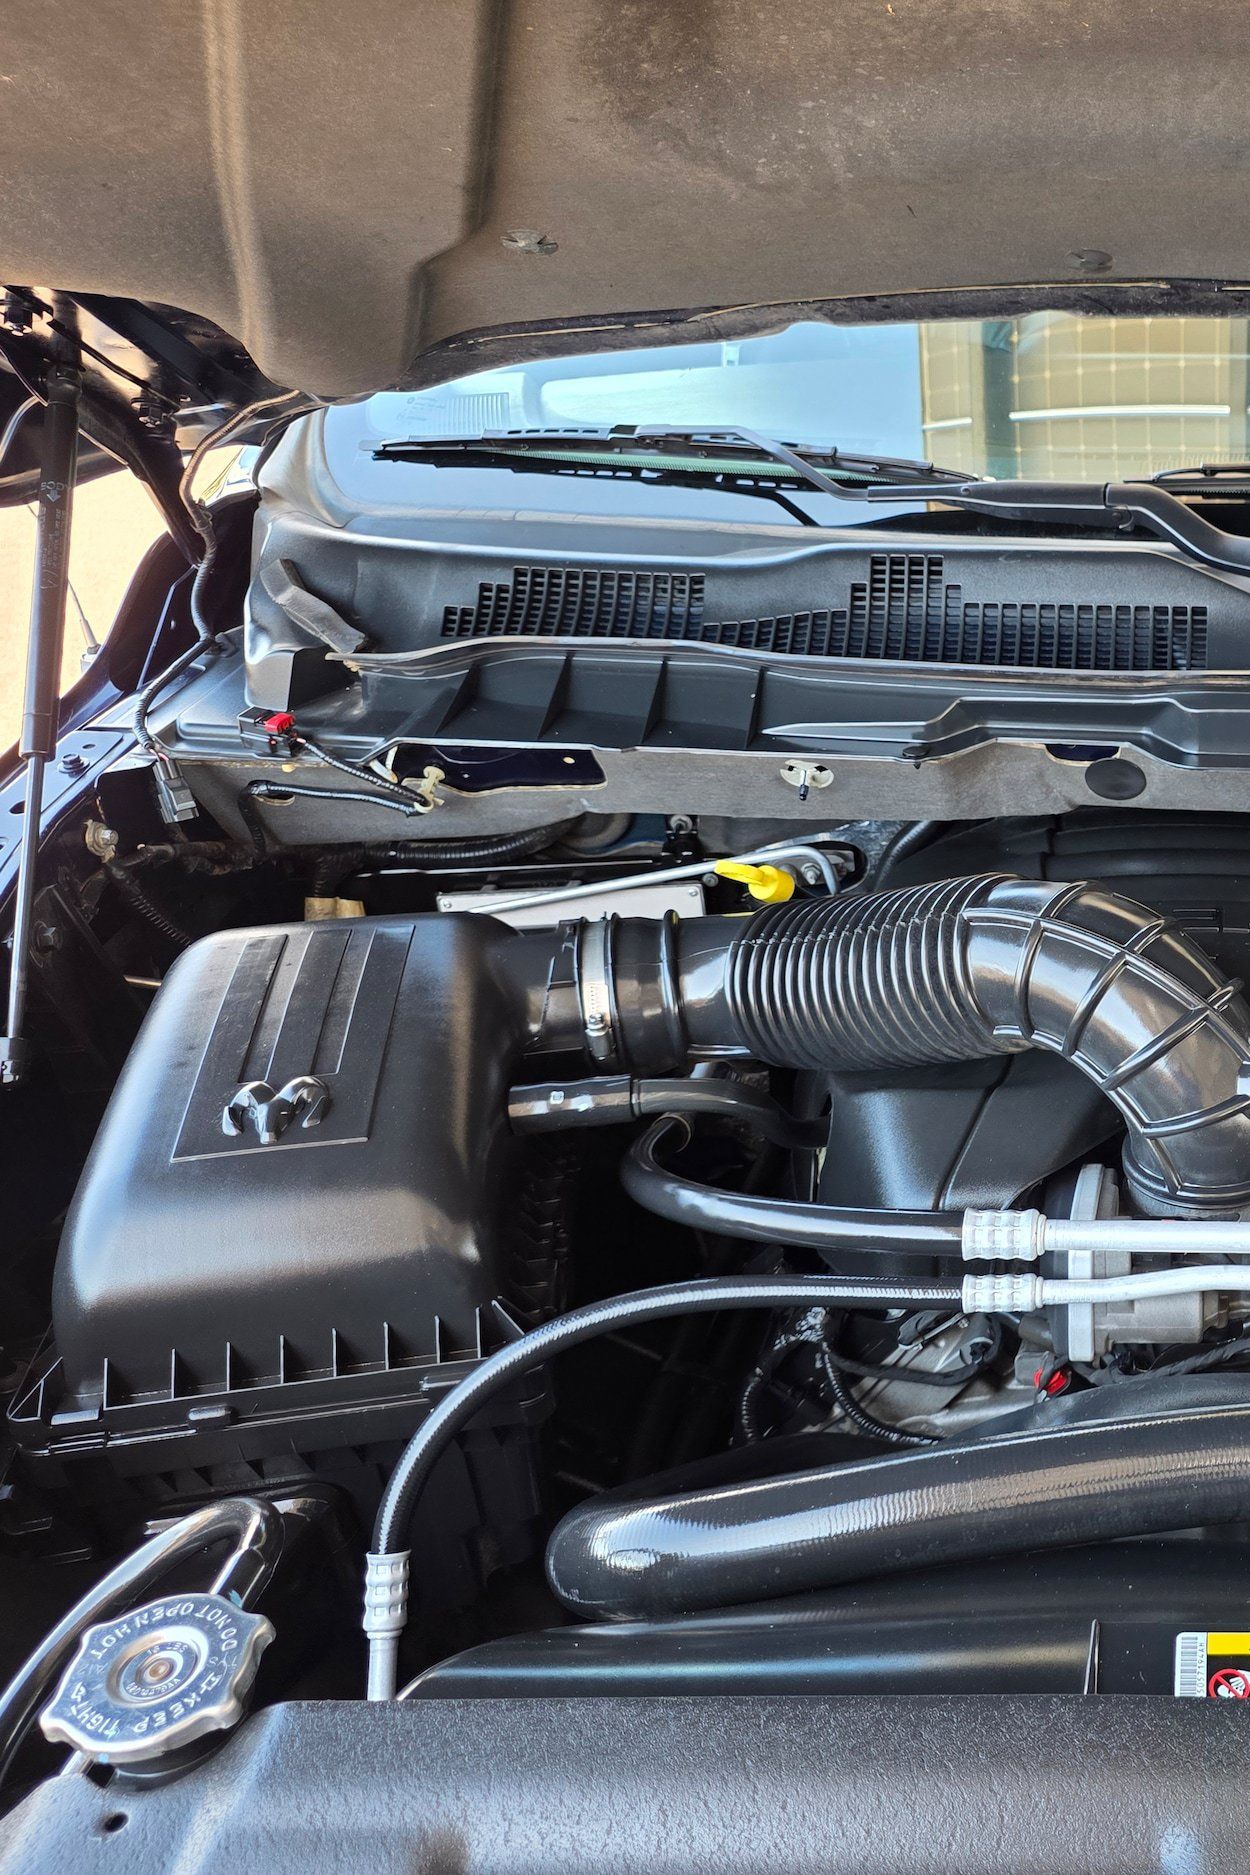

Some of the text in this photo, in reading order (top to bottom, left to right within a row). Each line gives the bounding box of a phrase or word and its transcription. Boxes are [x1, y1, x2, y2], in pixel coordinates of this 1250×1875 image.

[90, 1601, 238, 1660] DO NOT OPEN HOT
[71, 1692, 201, 1738] KEEP TIGHT
